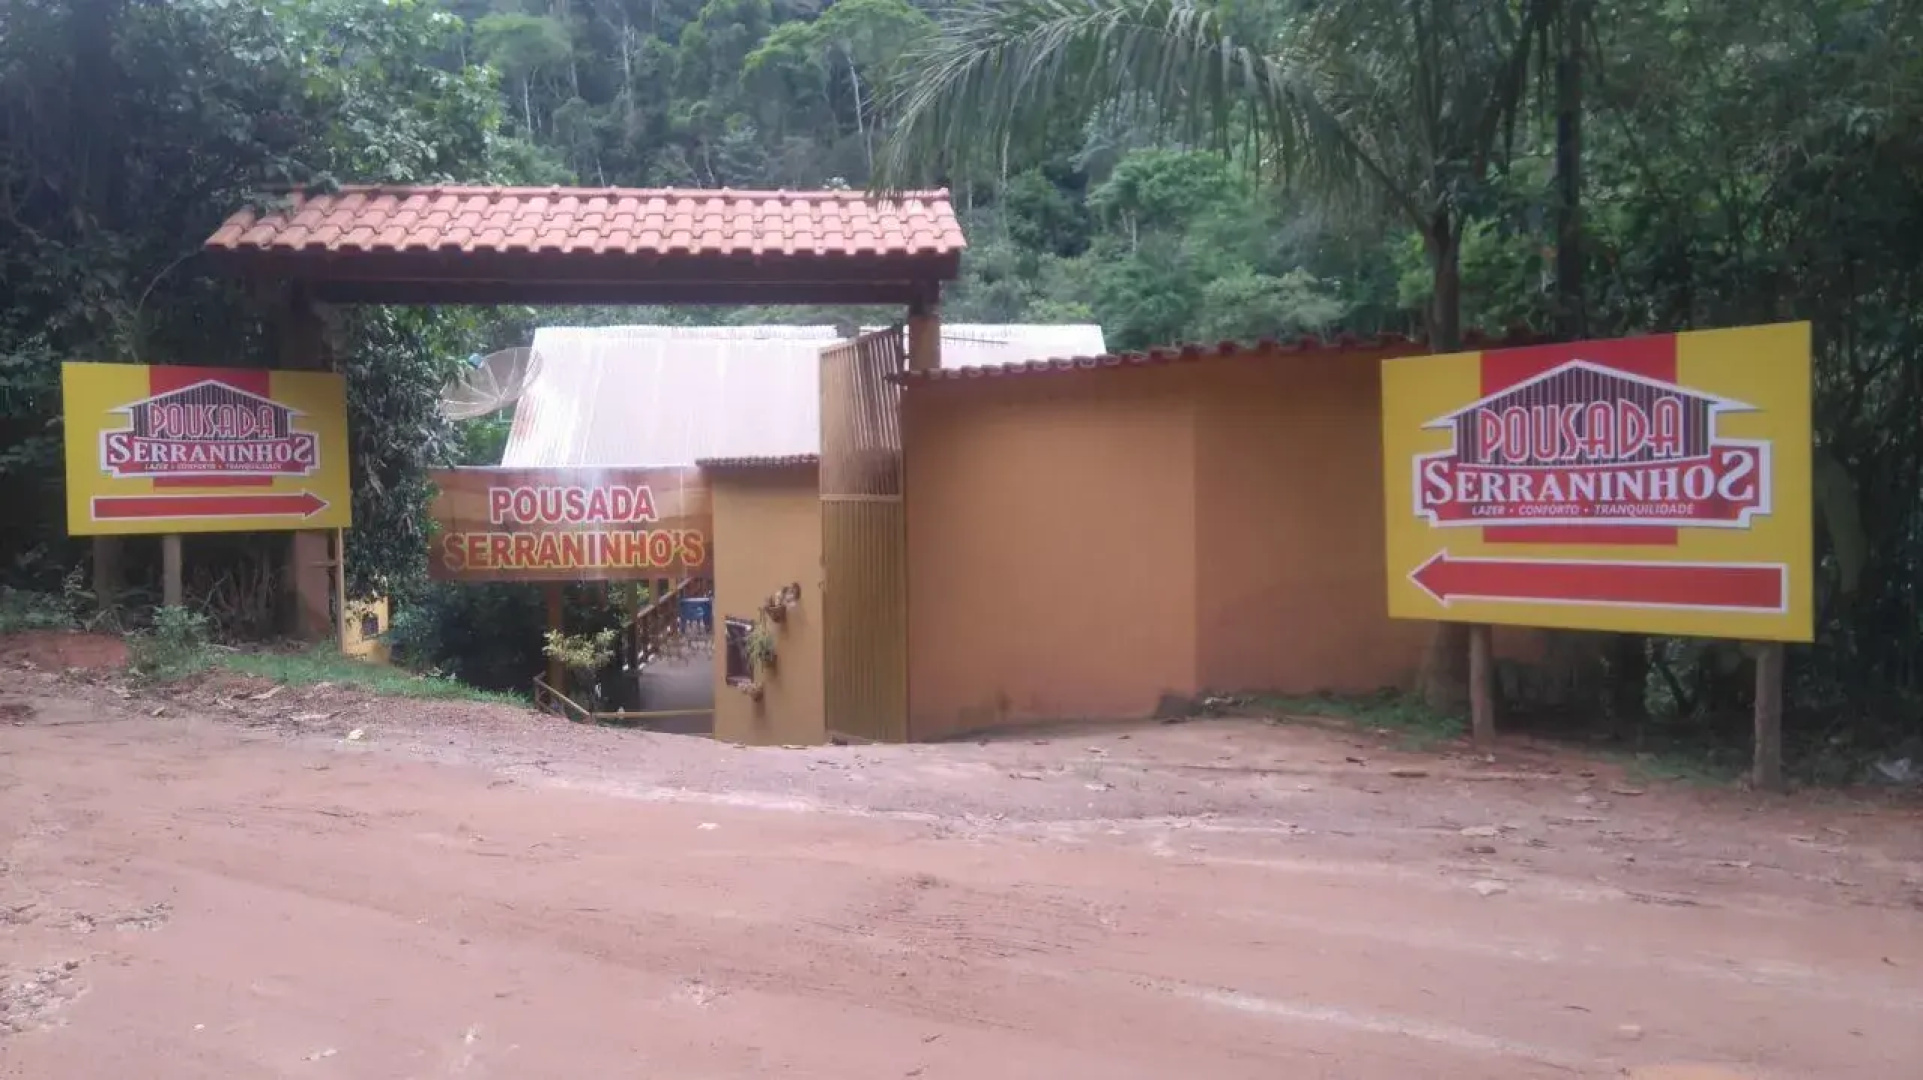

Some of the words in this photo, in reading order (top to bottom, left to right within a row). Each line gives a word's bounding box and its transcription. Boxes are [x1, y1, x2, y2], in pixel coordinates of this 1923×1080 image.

[150, 403, 275, 438] POUSADA
[1479, 396, 1683, 463] POUSADA
[109, 432, 314, 463] SERRANINHOS
[1425, 450, 1754, 505] SERRANINHOS
[489, 485, 658, 524] POUSADA
[1471, 504, 1505, 516] LAZER
[1518, 504, 1580, 516] CONFORTO
[1594, 502, 1695, 518] TRANQUILIDADE
[443, 529, 705, 571] SERRANINHO'S
